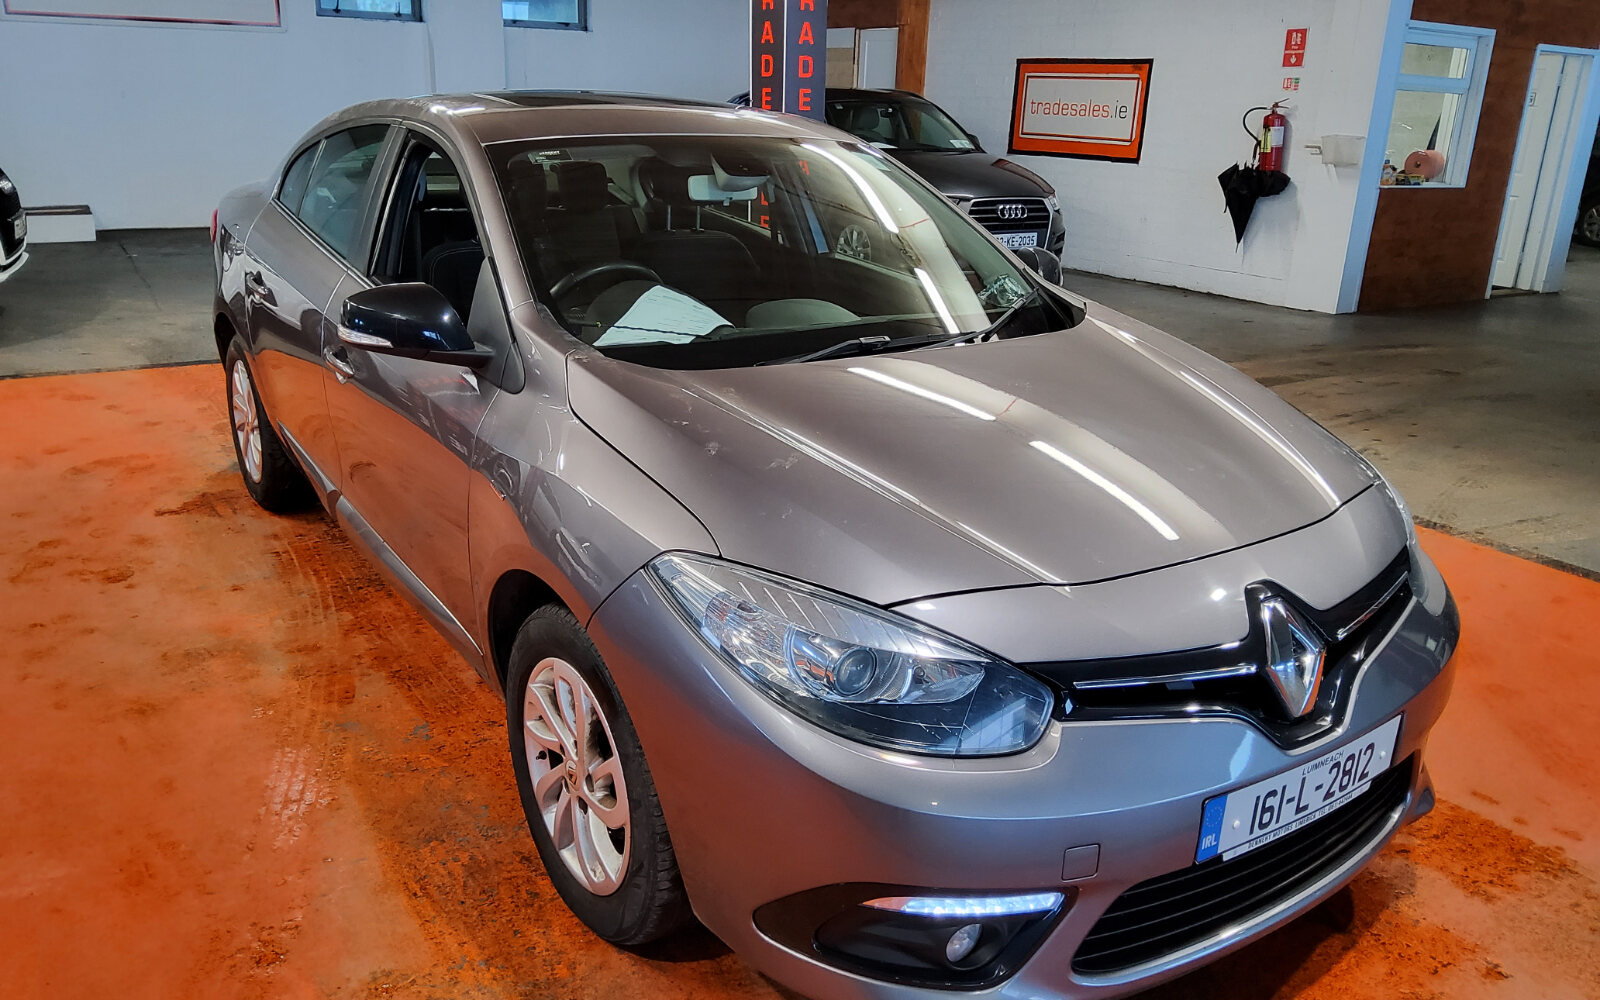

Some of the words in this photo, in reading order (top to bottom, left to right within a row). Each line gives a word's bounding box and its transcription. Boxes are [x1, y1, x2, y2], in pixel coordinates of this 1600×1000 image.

[1030, 98, 1128, 119] tradesales.ie
[996, 235, 1036, 247] 2-KE-2035
[1302, 750, 1344, 776] LUIMNEACH
[1201, 833, 1218, 850] IRL
